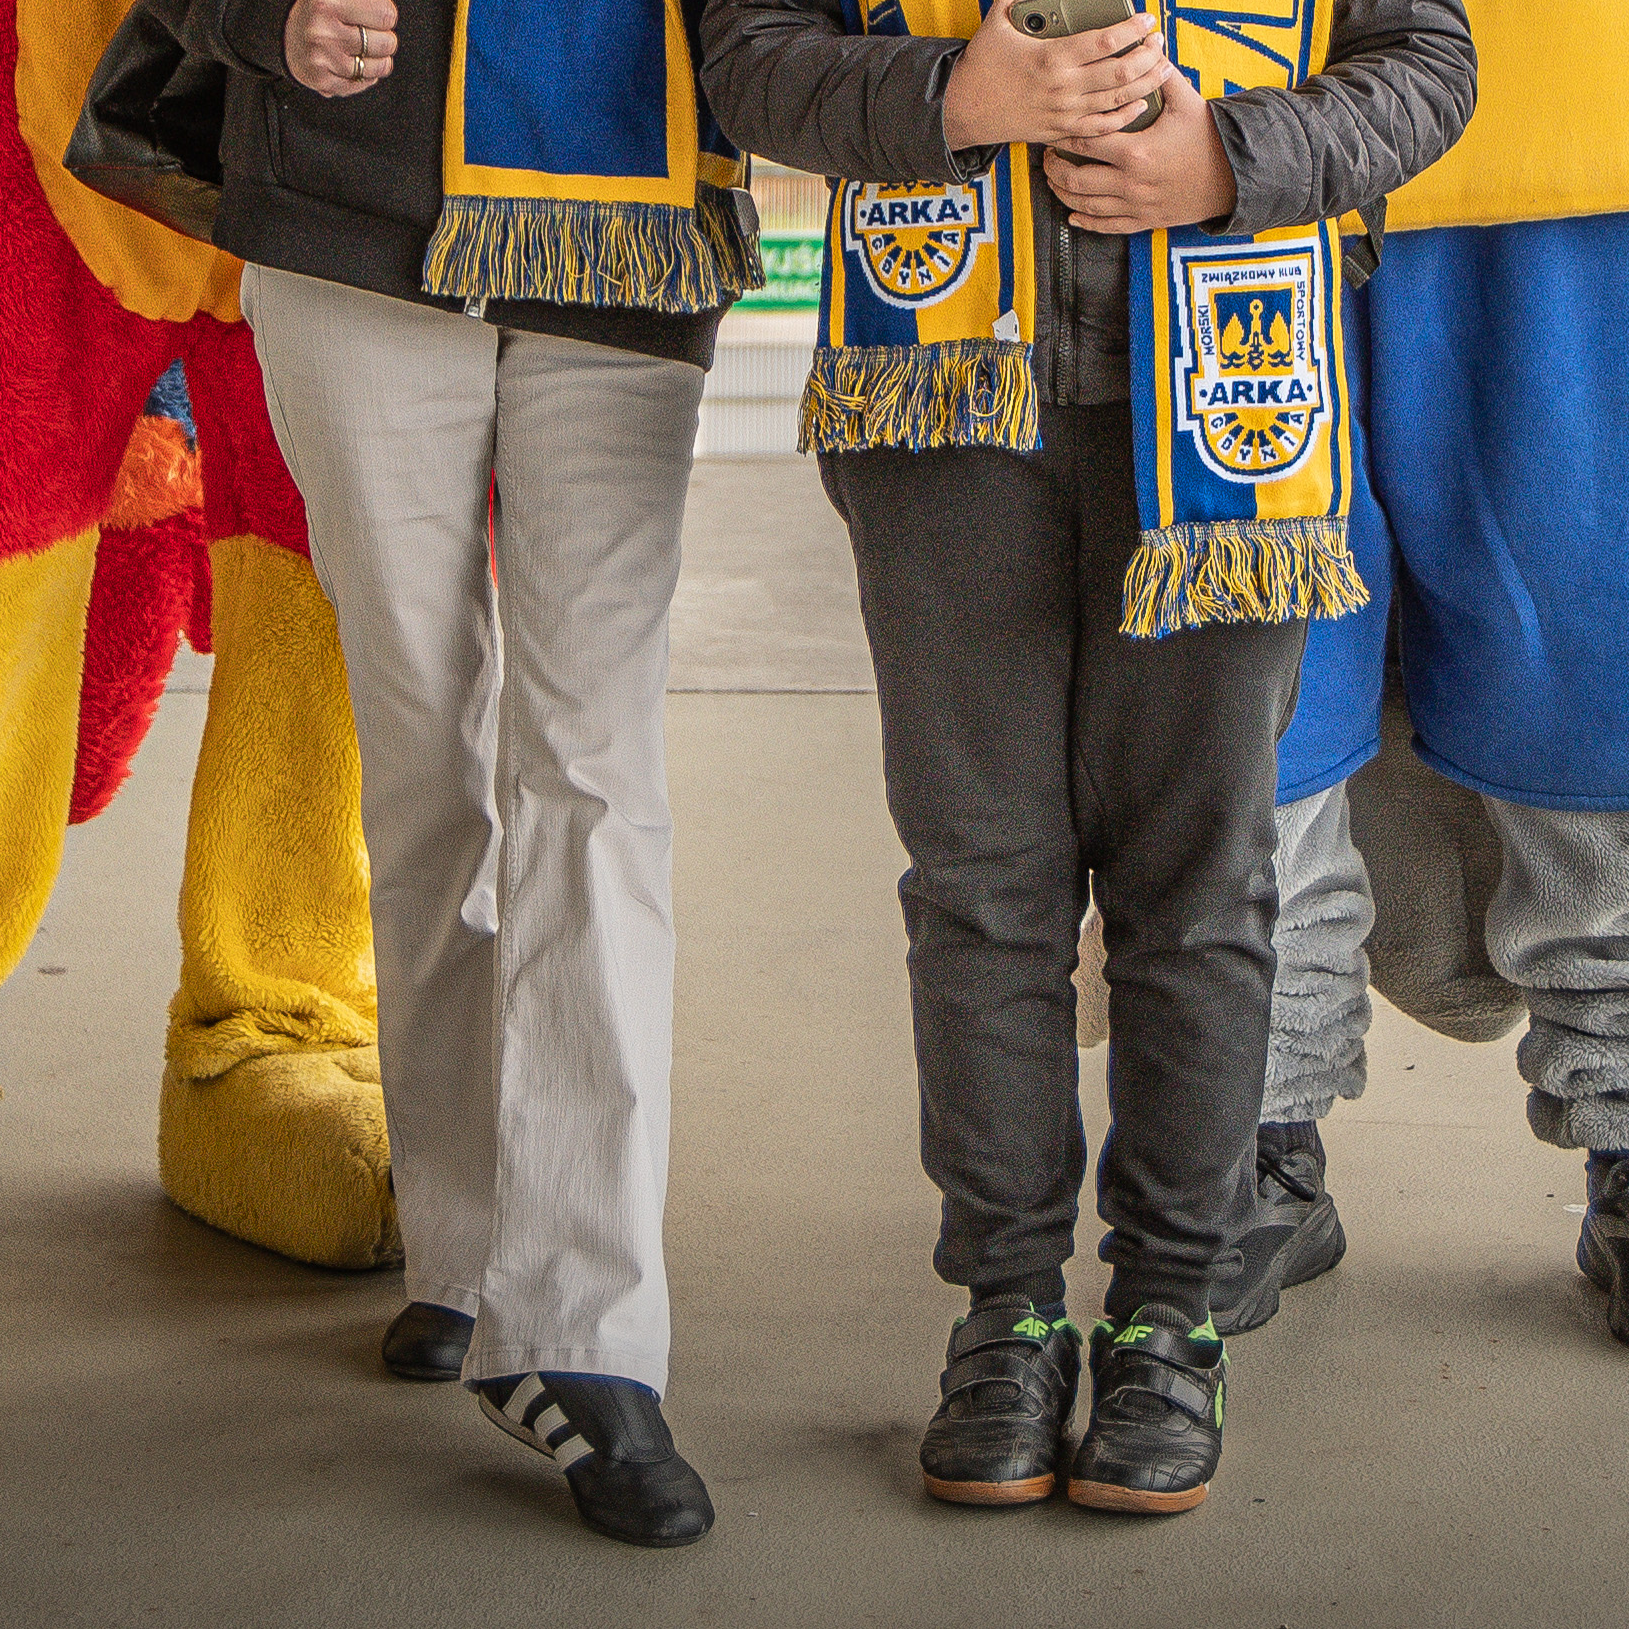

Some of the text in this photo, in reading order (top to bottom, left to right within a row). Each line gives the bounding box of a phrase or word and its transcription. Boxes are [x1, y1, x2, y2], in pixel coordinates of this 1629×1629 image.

[866, 198, 963, 226] ARKA
[871, 232, 960, 284] GDYNIA
[1201, 265, 1302, 285] ZWIĄZKOWY KLUB
[1197, 304, 1215, 356] MORSKI
[1295, 280, 1306, 361] SPORTOWY
[1207, 378, 1308, 407] ARKA
[1209, 412, 1304, 462] GDYNIA
